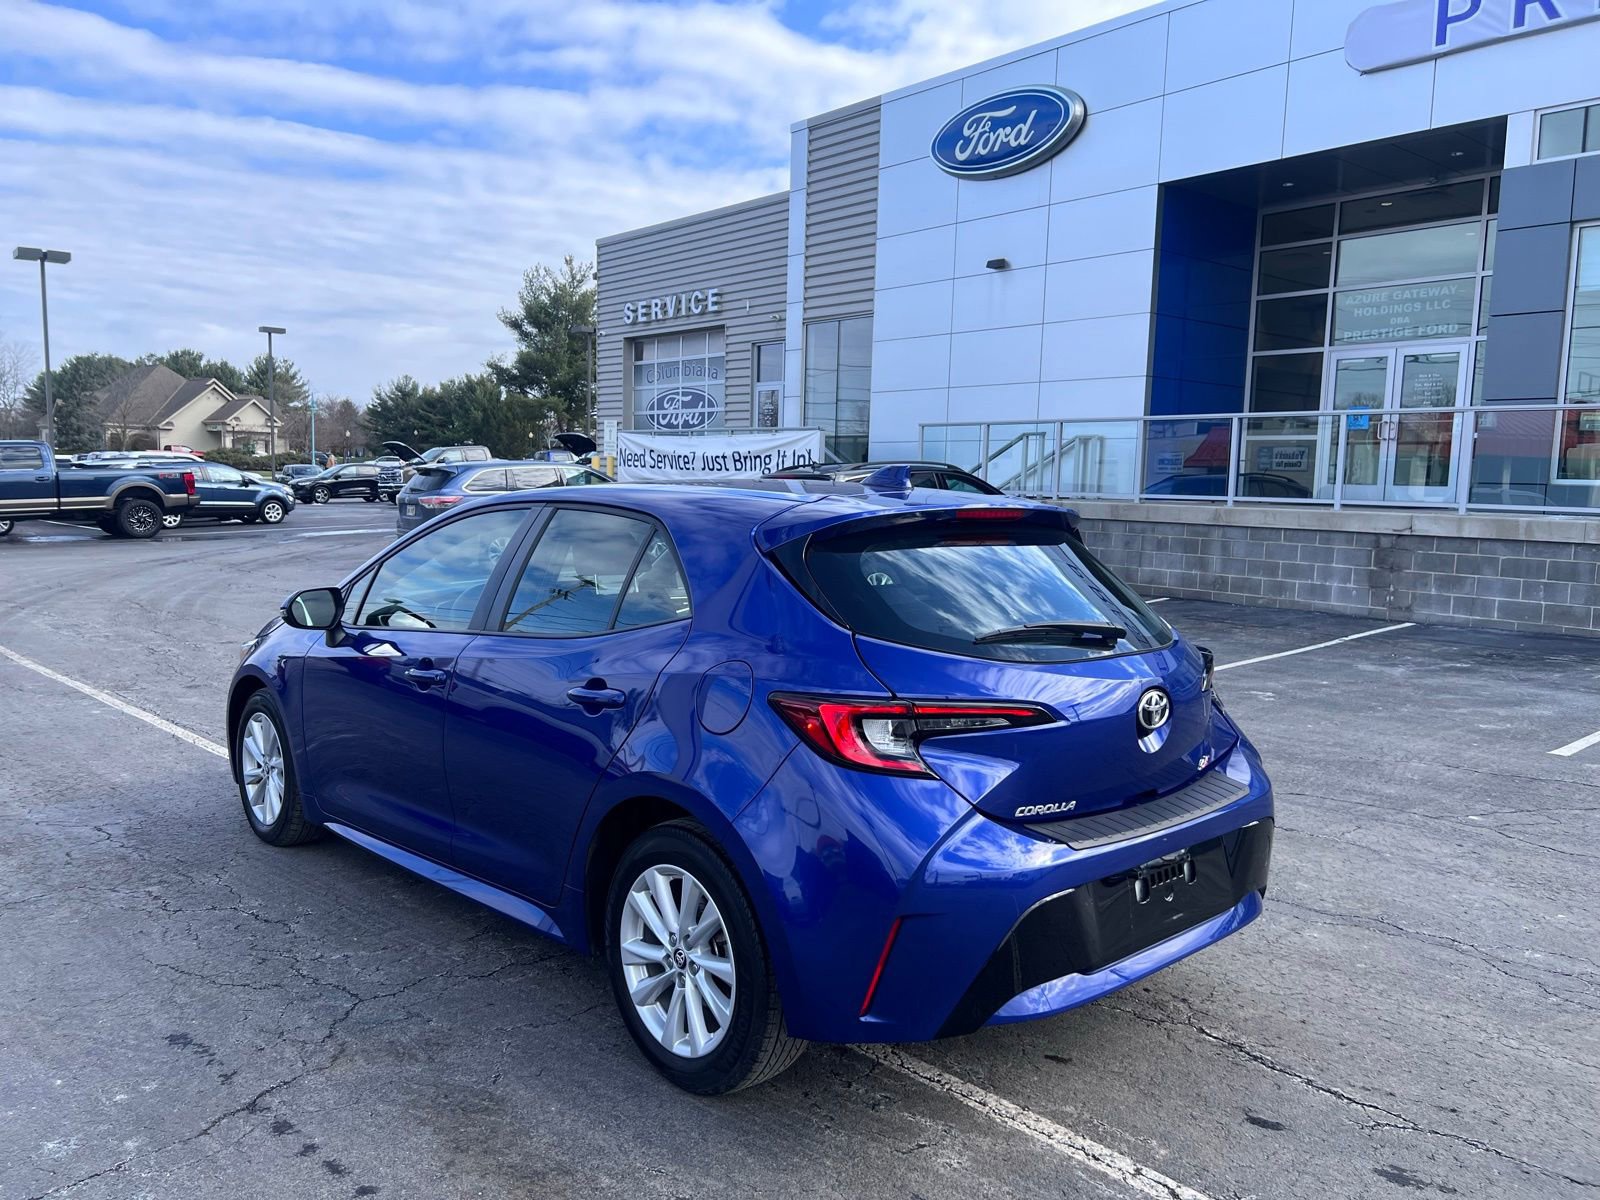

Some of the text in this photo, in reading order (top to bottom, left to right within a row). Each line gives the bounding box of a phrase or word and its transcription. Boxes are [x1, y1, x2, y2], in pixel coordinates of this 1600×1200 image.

[1434, 0, 1600, 47] PR
[954, 105, 1038, 161] Ford
[1346, 285, 1458, 305] AZURE GATEWAY
[624, 288, 718, 324] SERVICE
[1354, 300, 1451, 317] HOLDINGS LLC
[1390, 316, 1410, 325] DBA
[1343, 323, 1459, 341] PRESTIGE FORD
[646, 362, 718, 383] Columbiana
[659, 395, 703, 425] Ford
[619, 448, 646, 468] Need
[649, 449, 696, 471] Service?
[701, 451, 729, 471] Just
[732, 451, 772, 475] Bring
[776, 449, 787, 470] It
[1014, 800, 1077, 817] COROLLA
